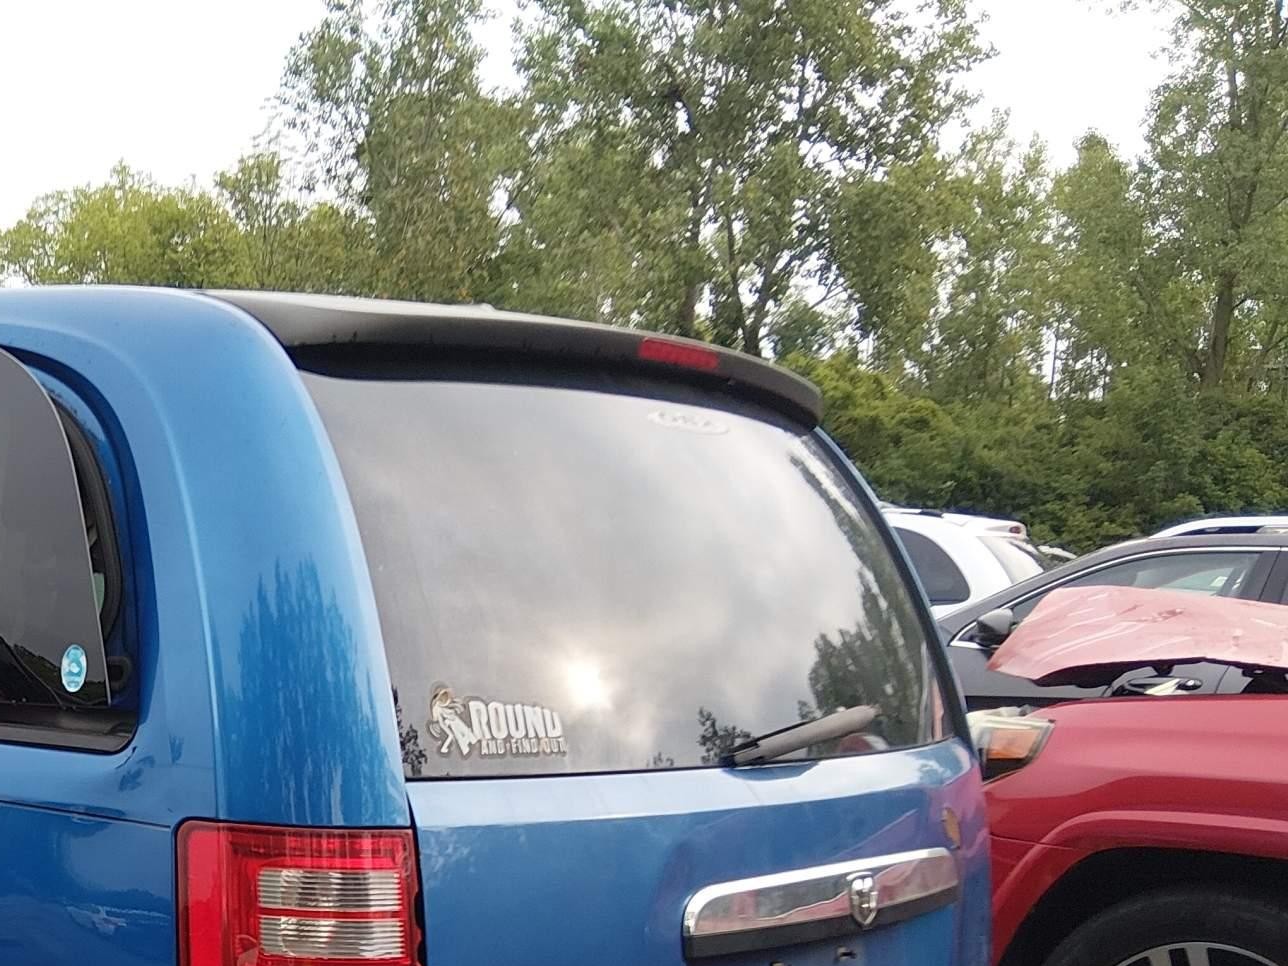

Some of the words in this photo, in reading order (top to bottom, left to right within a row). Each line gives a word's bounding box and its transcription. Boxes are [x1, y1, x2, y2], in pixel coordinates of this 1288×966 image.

[481, 738, 505, 755] AND
[511, 738, 539, 754] FIND
[544, 738, 567, 754] OUT
